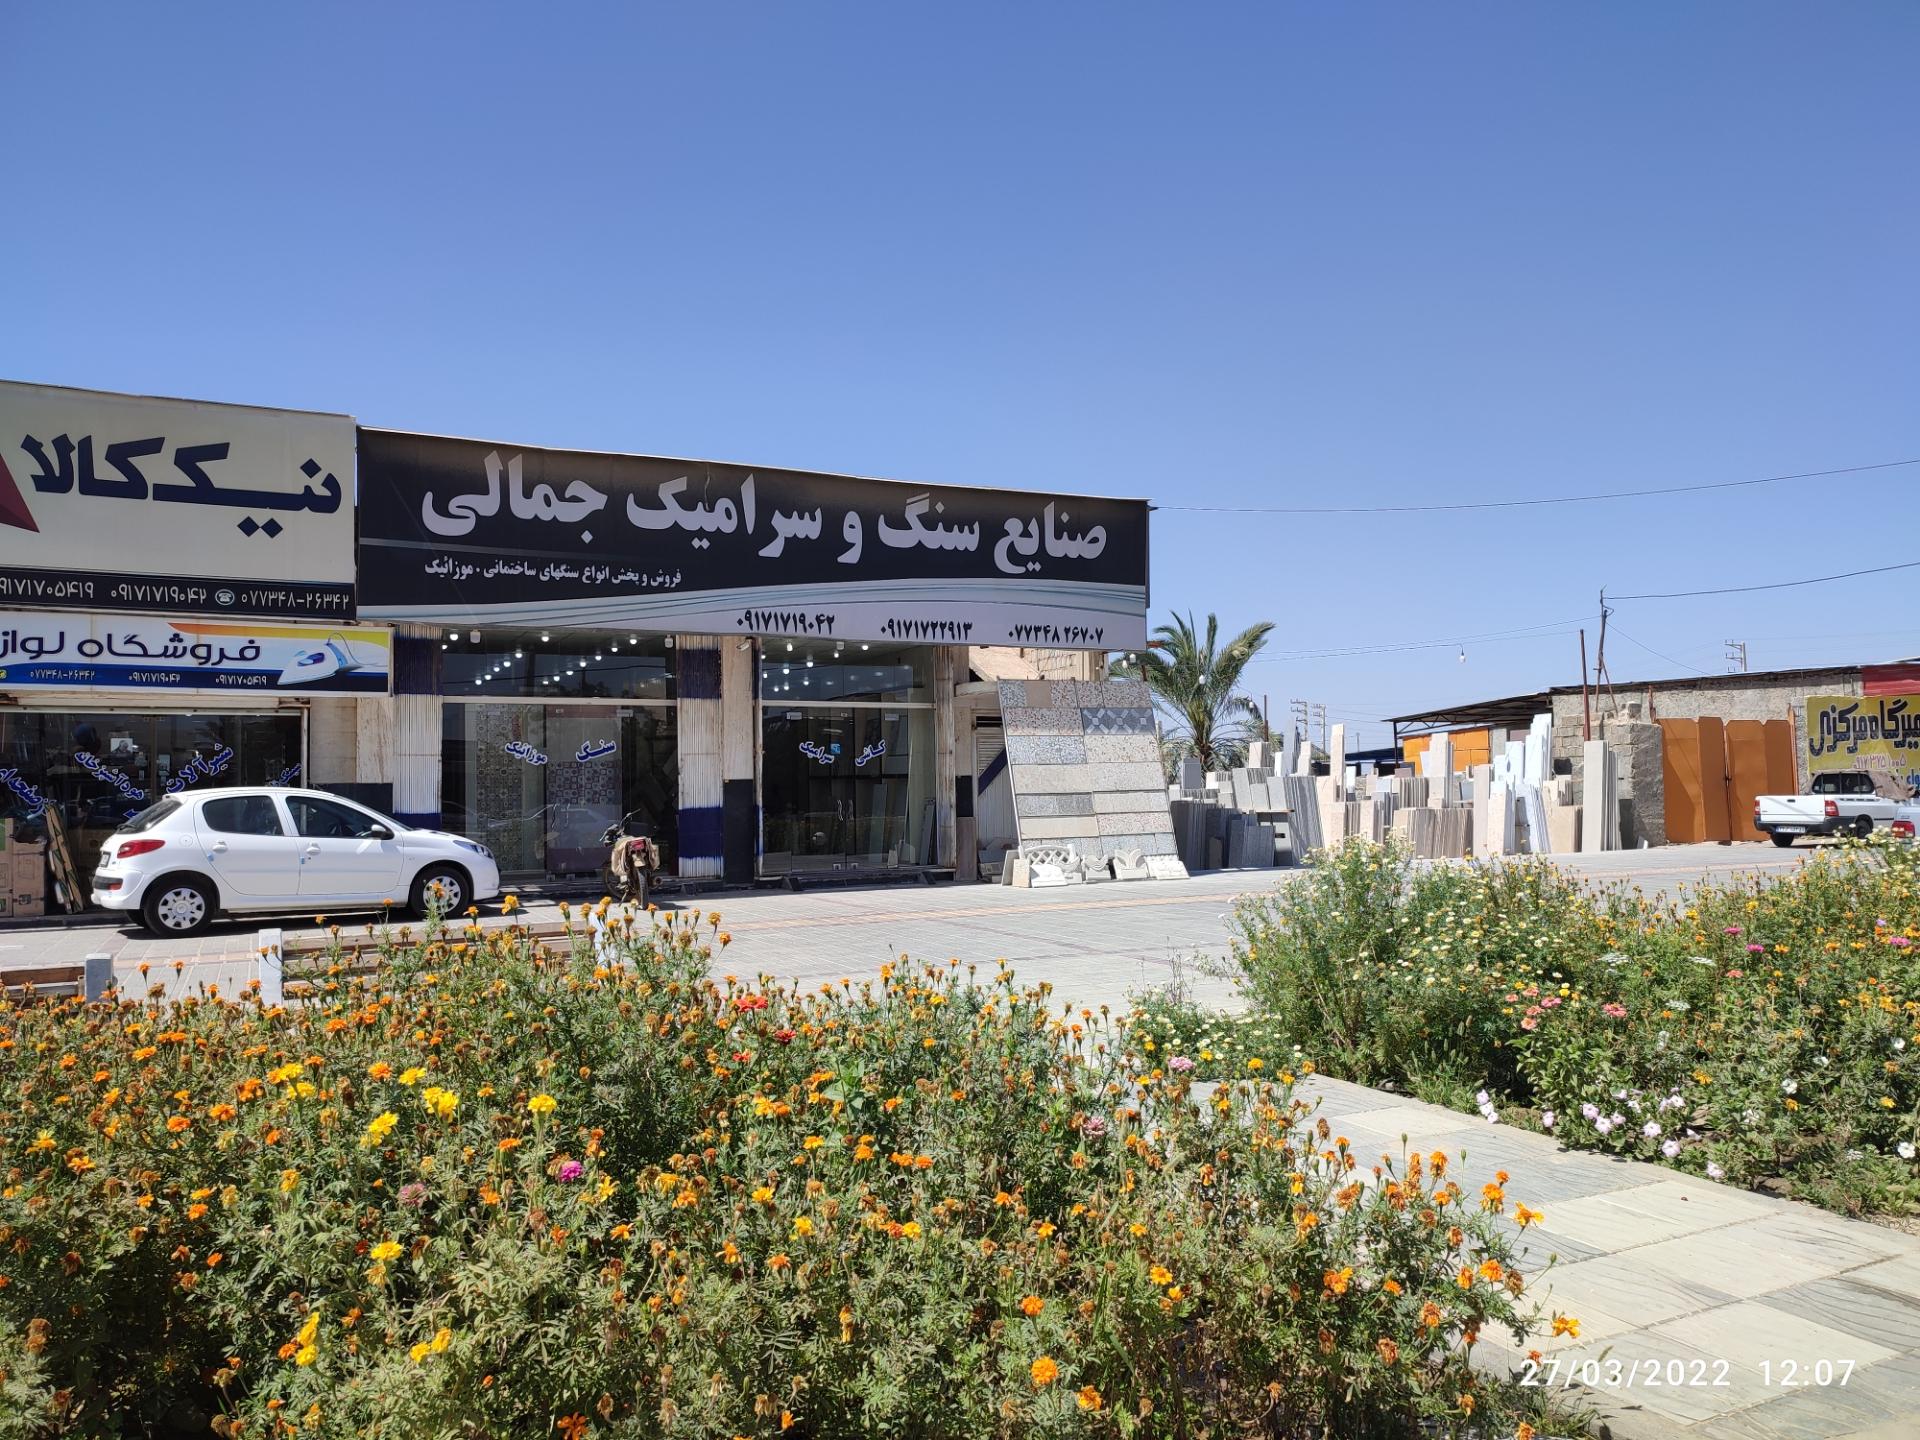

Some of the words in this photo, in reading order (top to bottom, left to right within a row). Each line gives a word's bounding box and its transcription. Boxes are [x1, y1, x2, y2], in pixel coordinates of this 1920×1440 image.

[421, 450, 608, 545] جمالی
[626, 473, 823, 559] سرامیک
[877, 492, 980, 552] سنگ
[836, 510, 863, 565] و
[993, 500, 1107, 574] صنایع
[483, 559, 537, 578] ساختمانی
[539, 562, 580, 581] سنگهای
[581, 564, 610, 584] انواع
[611, 567, 639, 586] پخش
[641, 572, 648, 587] و
[650, 568, 682, 588] فروش
[737, 610, 835, 635] ۰۹۱۷۱۷۱۹۰۴۲
[77, 632, 261, 666] فروشگاه
[576, 738, 616, 762] سنگ
[799, 741, 834, 764] سرامیک
[855, 739, 887, 766] کاشی
